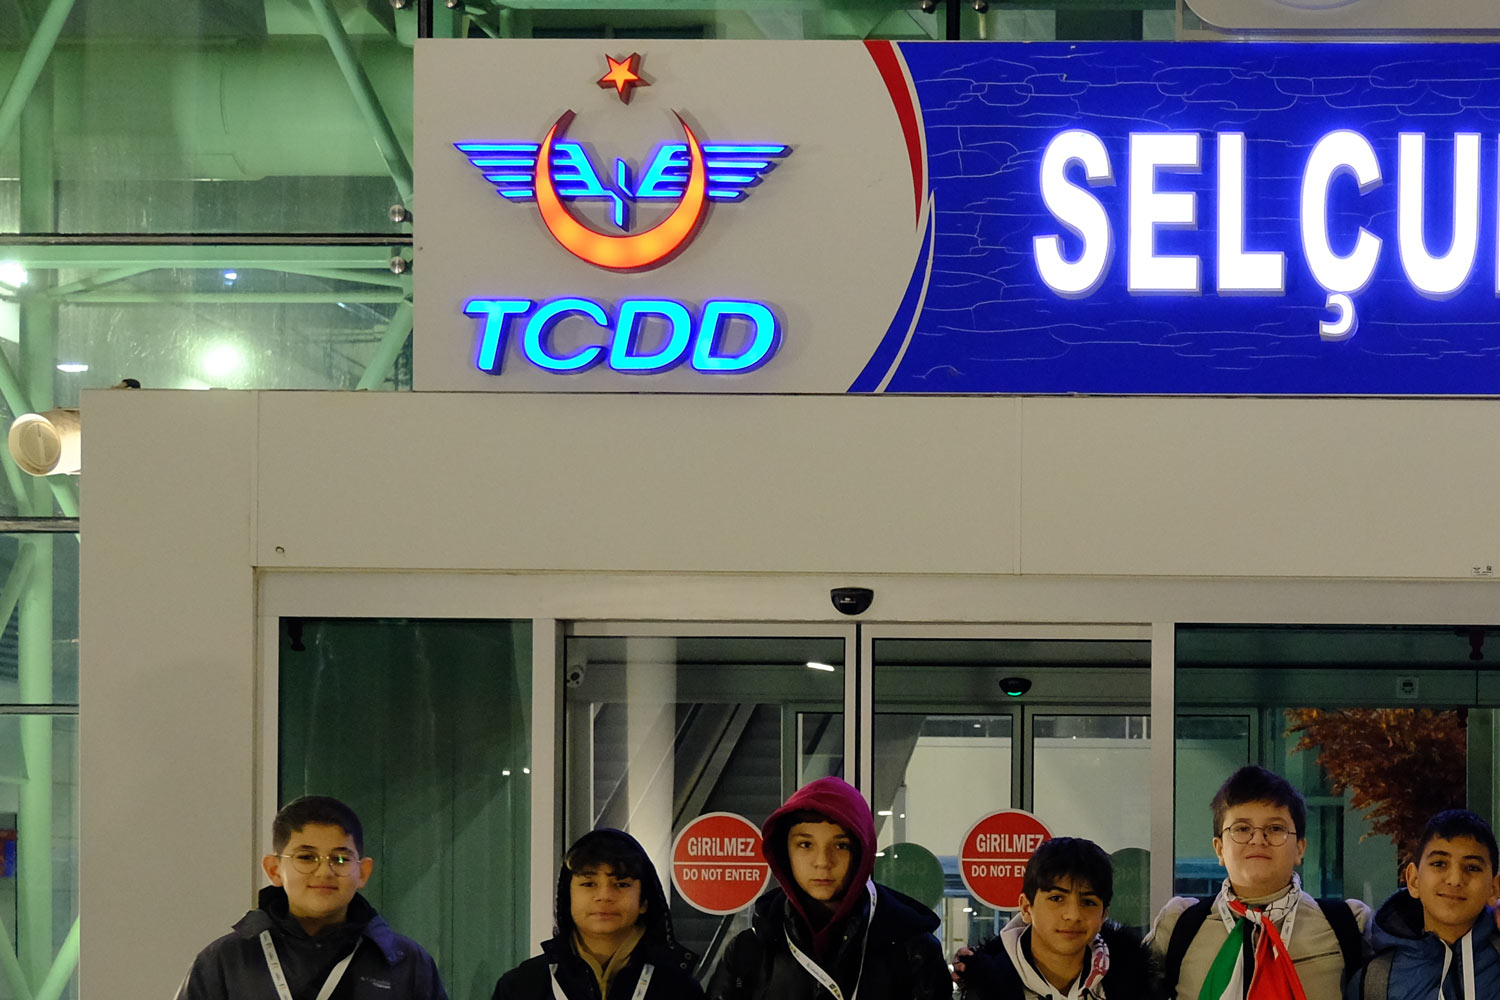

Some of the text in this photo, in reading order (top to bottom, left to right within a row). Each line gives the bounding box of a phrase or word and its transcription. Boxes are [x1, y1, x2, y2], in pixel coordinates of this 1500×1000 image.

[464, 297, 782, 375] TCDD
[683, 868, 760, 880] DO NOT ENTER
[971, 865, 987, 877] DO
[990, 865, 1012, 877] NOT
